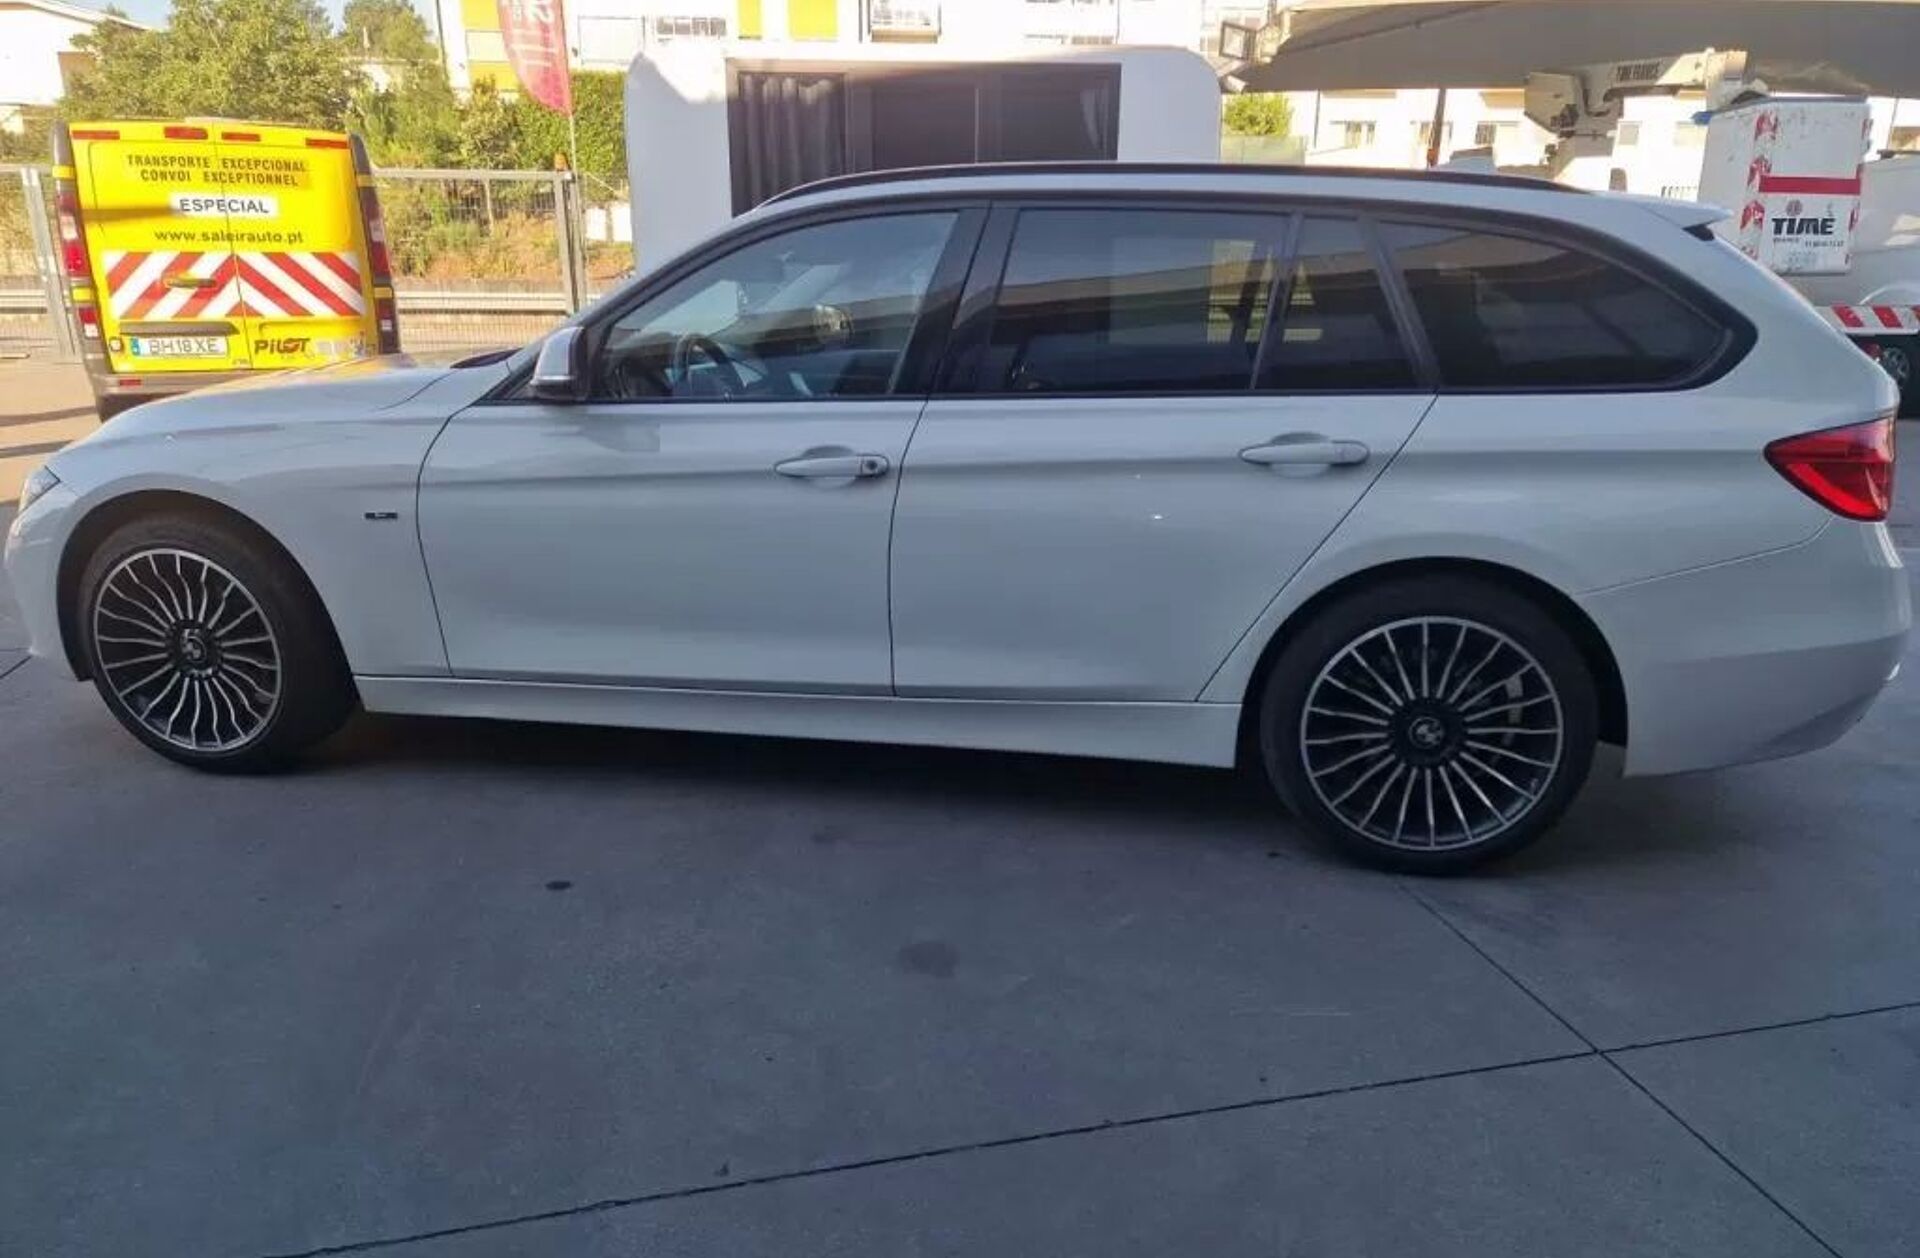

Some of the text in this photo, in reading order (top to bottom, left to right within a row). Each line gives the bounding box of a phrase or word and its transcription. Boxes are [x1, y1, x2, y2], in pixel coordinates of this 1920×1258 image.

[128, 154, 306, 172] TRANSPORTE EXCEPCIONAL
[140, 169, 298, 187] CONVOI EXCEPTIONNEL
[179, 198, 270, 214] ESPECIAL
[1772, 217, 1836, 236] TIME
[154, 229, 304, 245] www.saleirauto.pt
